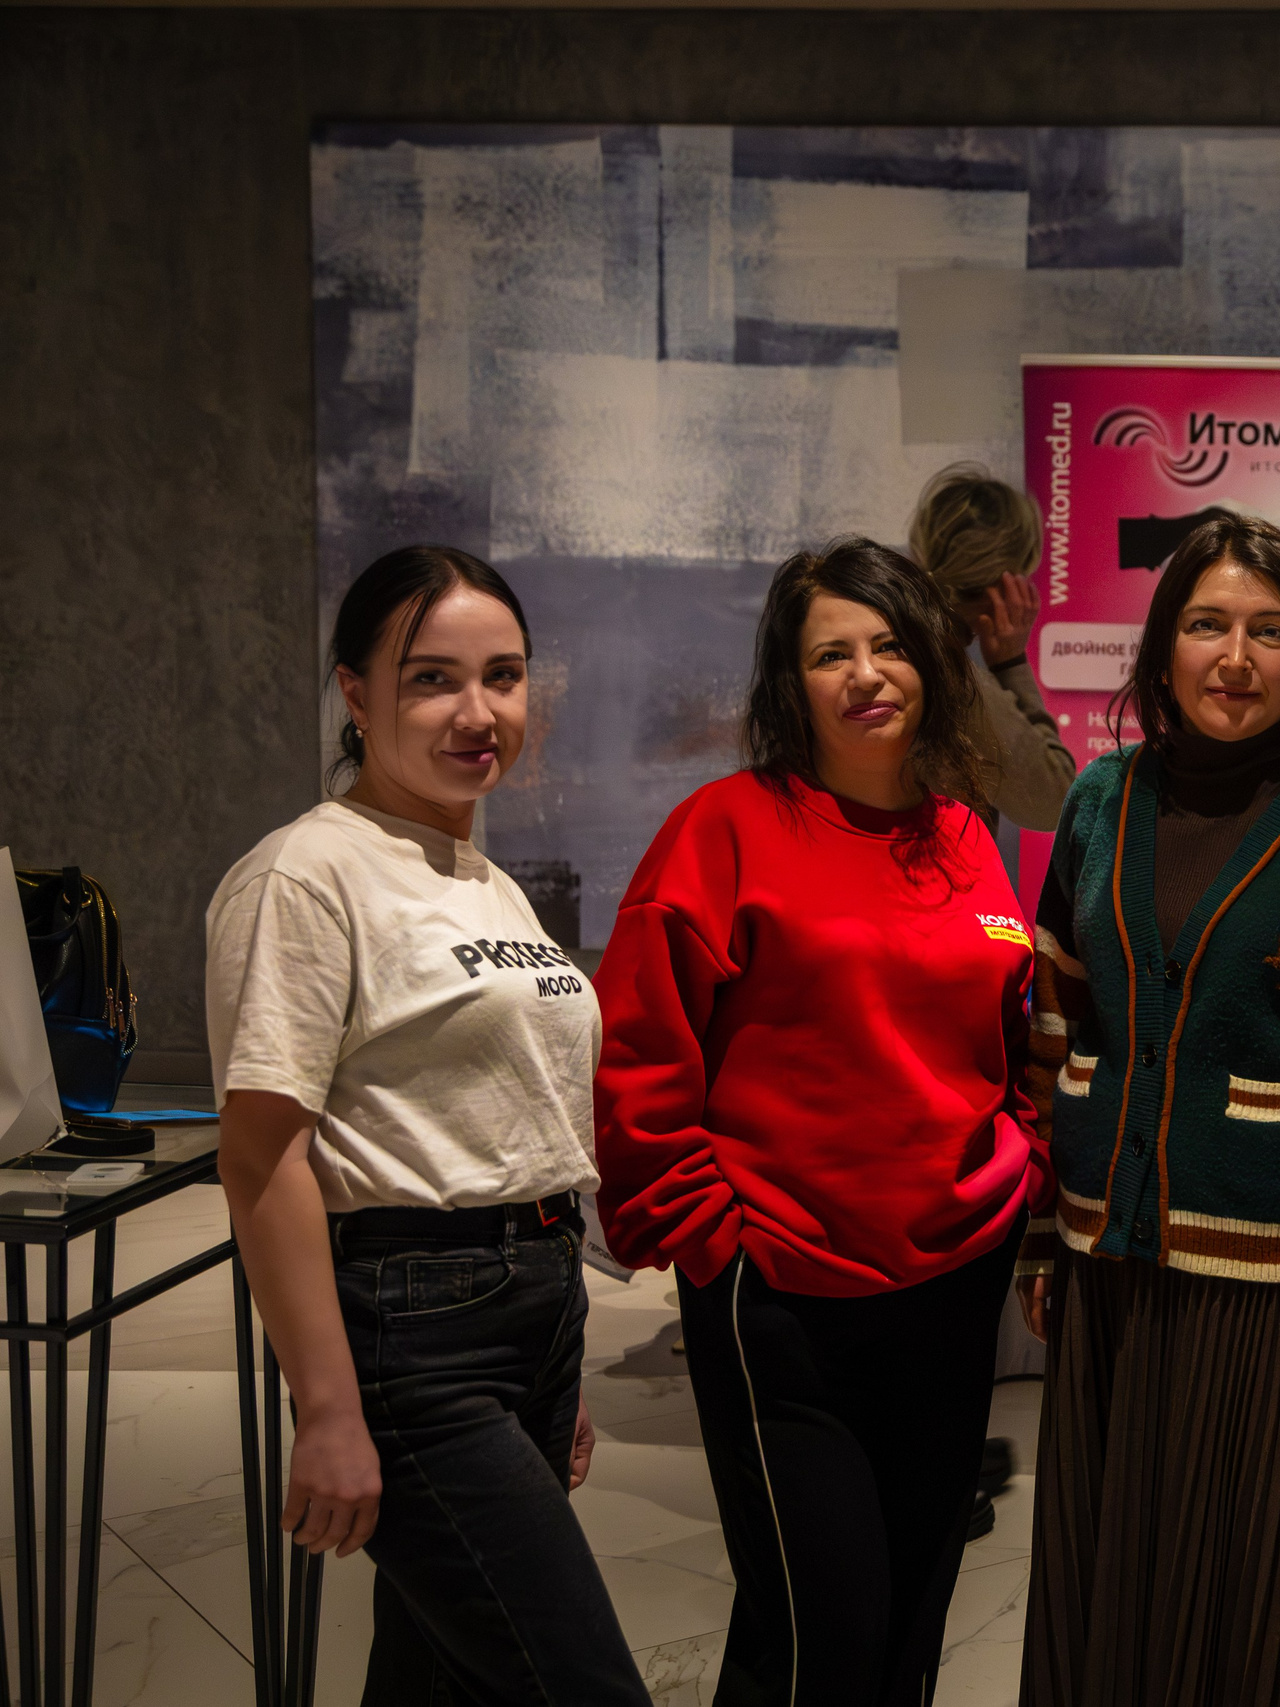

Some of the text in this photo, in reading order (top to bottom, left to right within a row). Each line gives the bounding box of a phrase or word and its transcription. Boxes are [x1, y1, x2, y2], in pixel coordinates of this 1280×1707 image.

[1045, 401, 1072, 607] www.itomed.ru
[1051, 640, 1126, 657] ДВОЙНОЕ
[450, 938, 572, 979] PROSECC
[535, 975, 583, 997] MOOD
